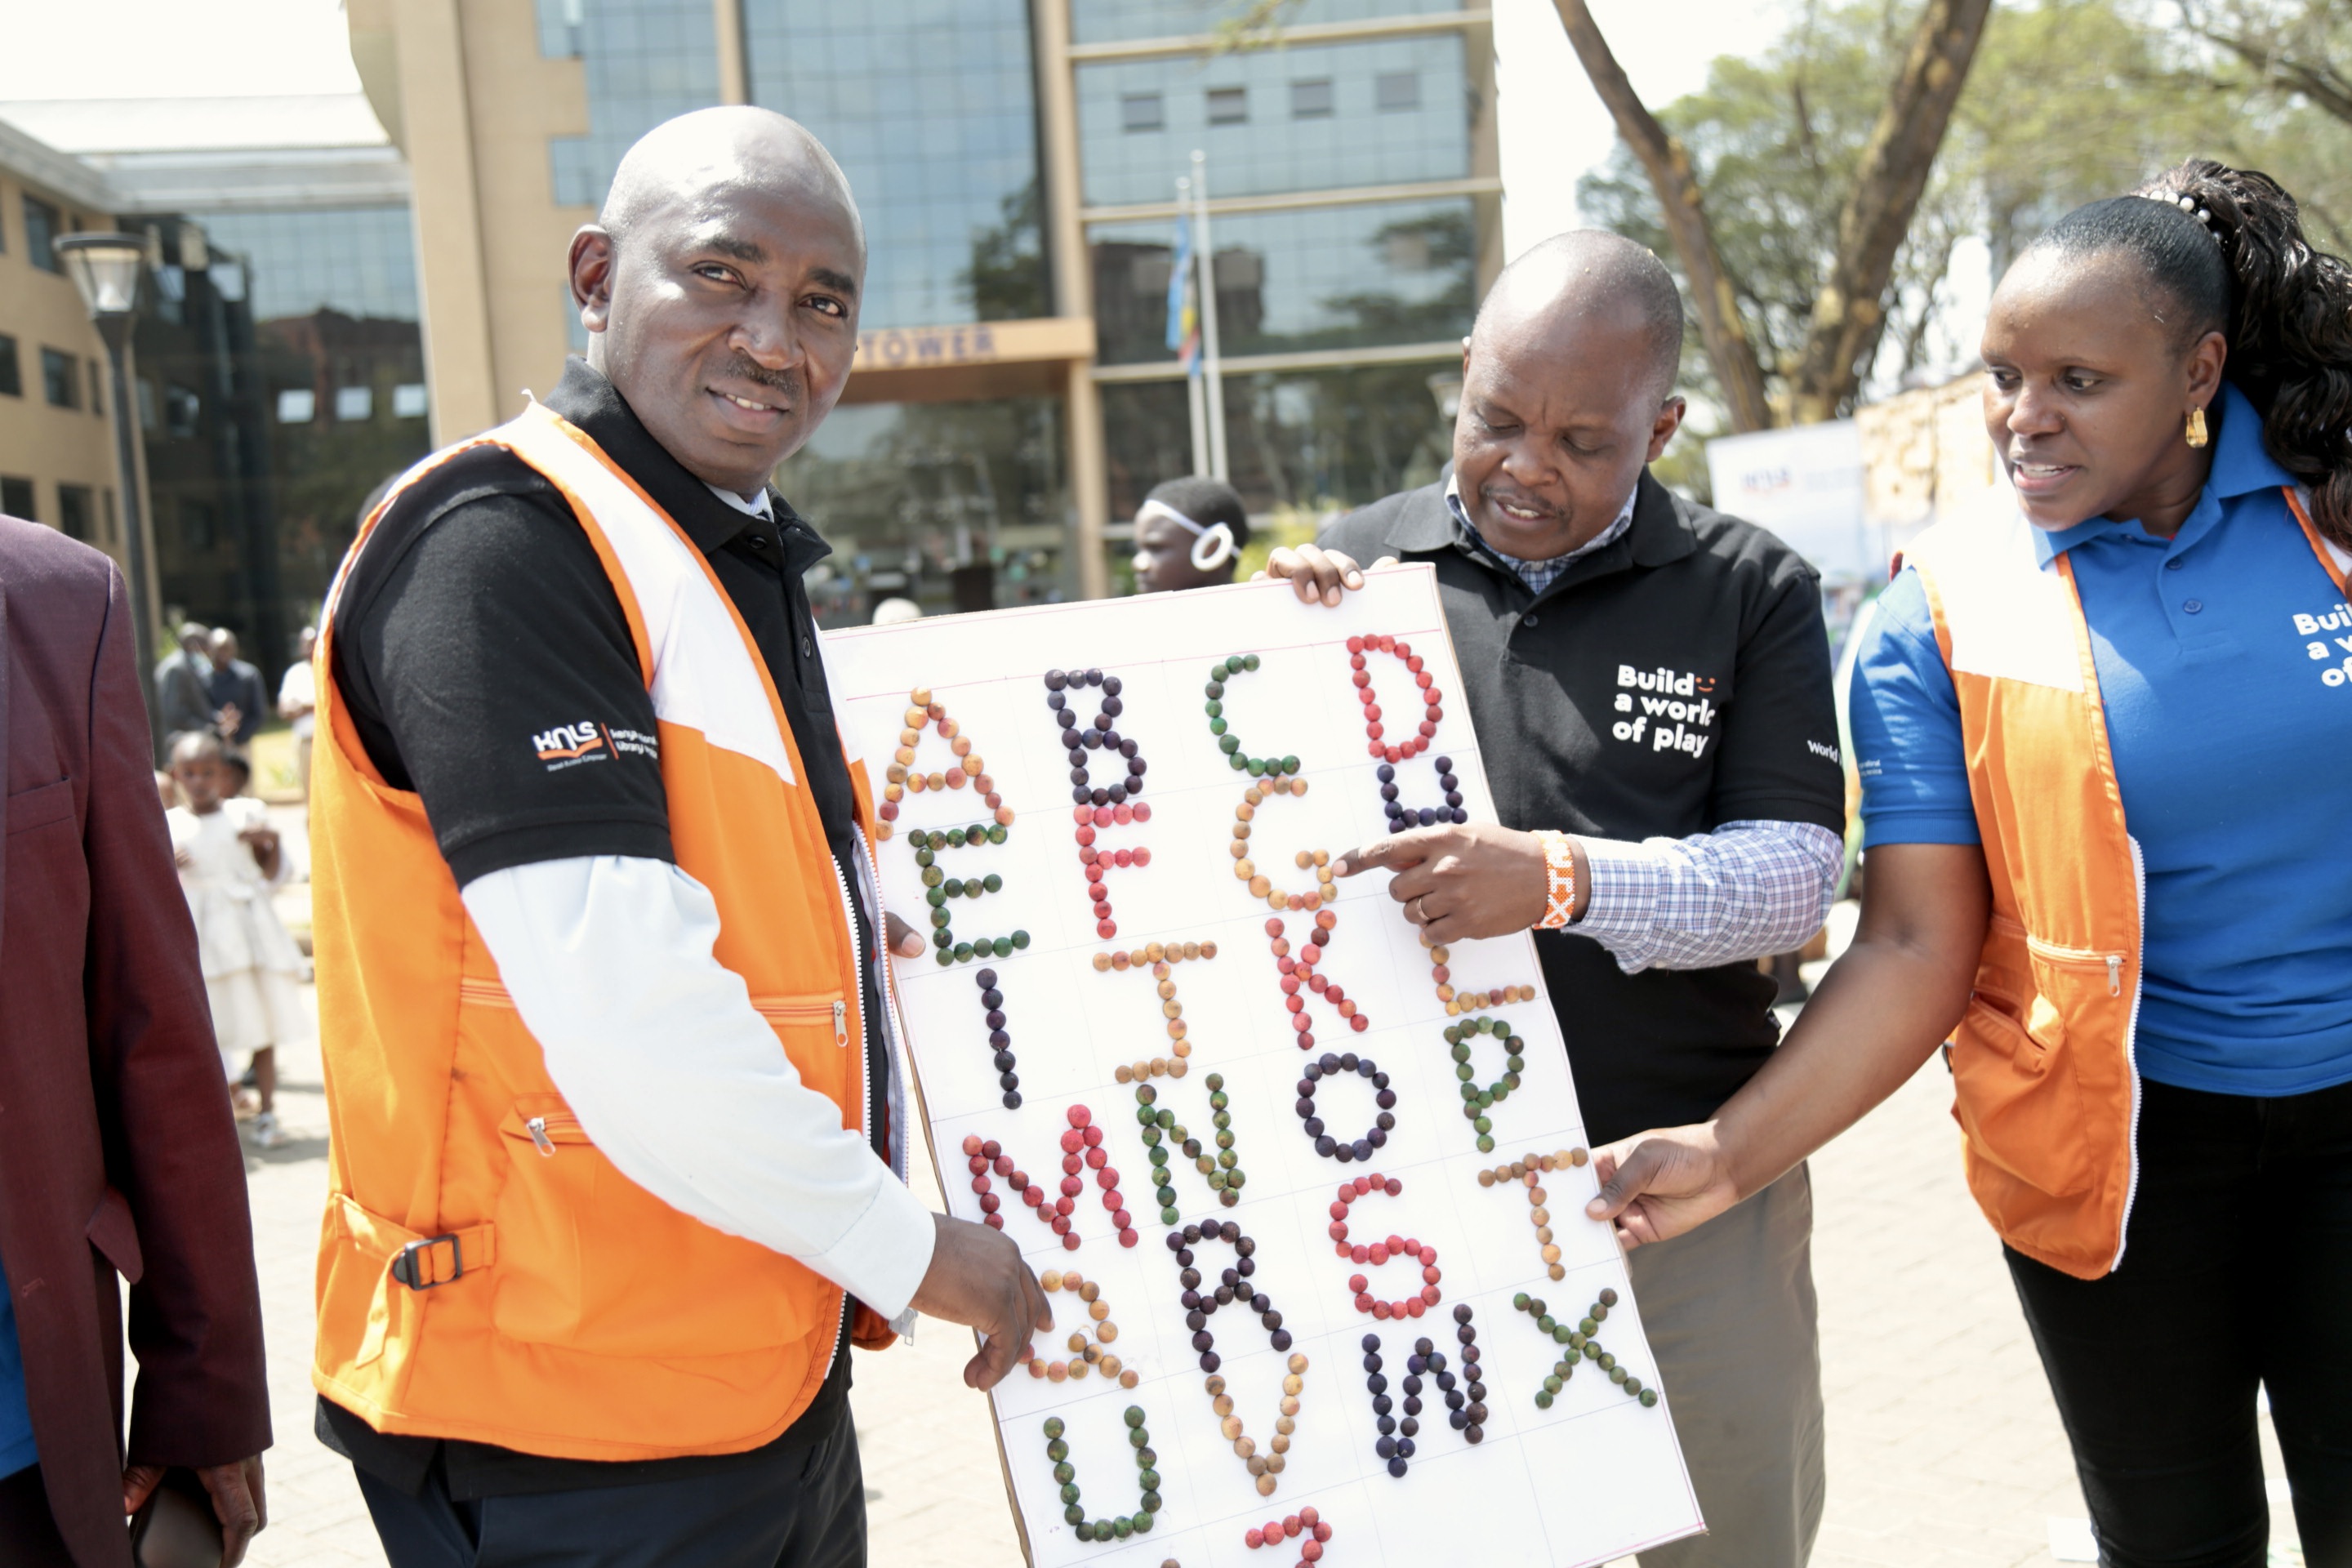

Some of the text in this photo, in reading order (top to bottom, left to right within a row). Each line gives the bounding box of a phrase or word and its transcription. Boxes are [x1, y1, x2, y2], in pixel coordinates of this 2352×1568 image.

[859, 328, 996, 363] TOWER
[1615, 693, 1633, 712] a
[1618, 664, 1695, 697] Build
[2306, 641, 2330, 660] a
[875, 634, 1442, 840] A B C D
[1612, 716, 1709, 759] of play
[1807, 740, 1838, 763] World
[908, 824, 1030, 965] E
[1074, 802, 1151, 939] F
[1230, 776, 1338, 910] G
[976, 910, 1535, 1109] I J K L
[962, 1016, 1525, 1250] M N O P
[1166, 1218, 1292, 1373] R
[1329, 1173, 1441, 1320] S
[1477, 1147, 1588, 1281] T
[1043, 1405, 1162, 1542] U
[1205, 1352, 1308, 1496] V
[1361, 1303, 1488, 1478] W
[1513, 1288, 1658, 1409] X
